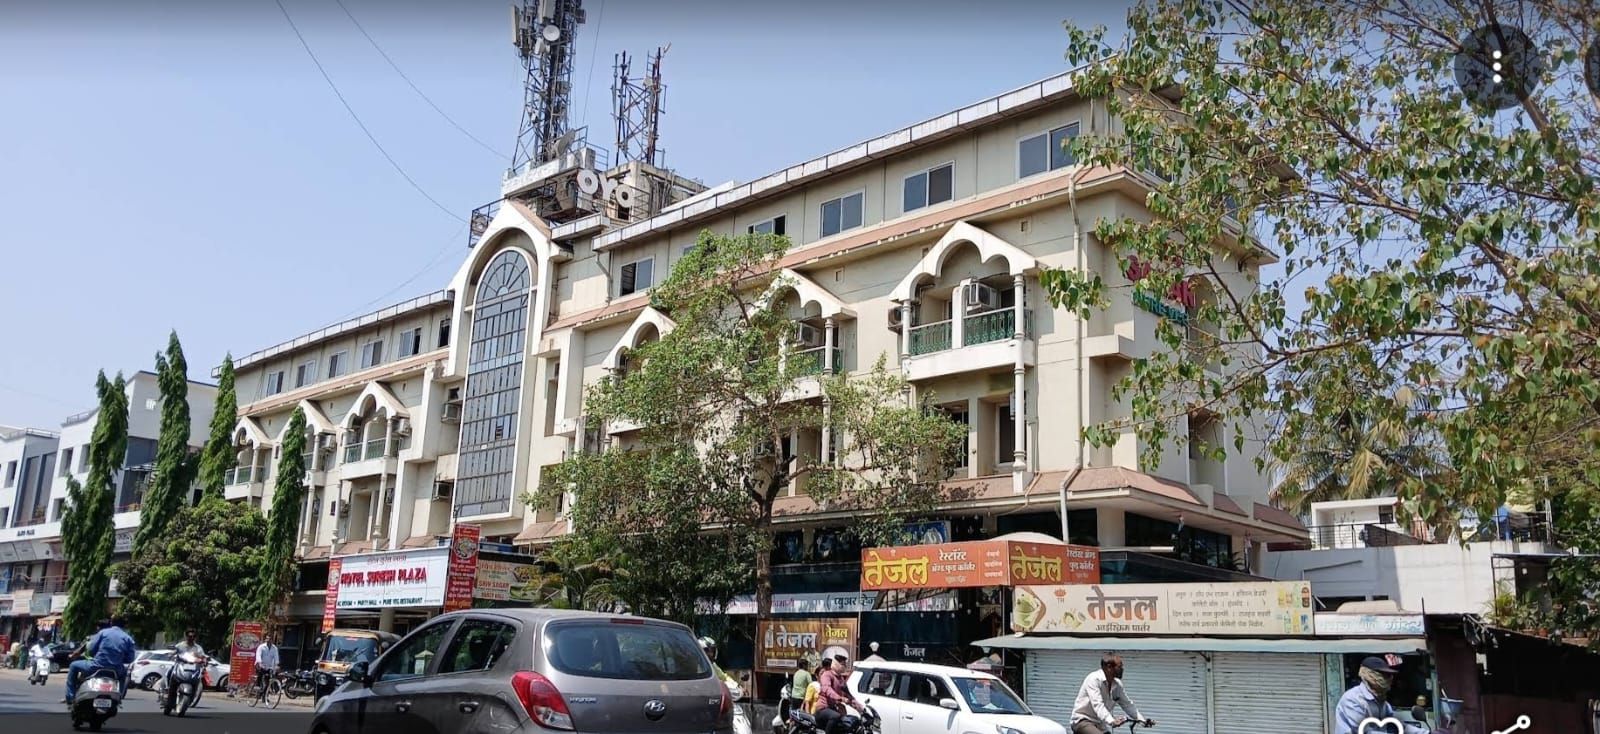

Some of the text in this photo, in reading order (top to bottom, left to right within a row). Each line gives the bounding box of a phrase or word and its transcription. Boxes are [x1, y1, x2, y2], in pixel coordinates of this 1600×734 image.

[398, 567, 427, 582] PLAZA
[864, 550, 929, 586] तेजल
[1010, 546, 1062, 582] तेजल
[1086, 585, 1158, 621] तेजल
[776, 624, 818, 648] तेजल
[825, 625, 849, 639] तेजल
[904, 644, 926, 657] तेजल
